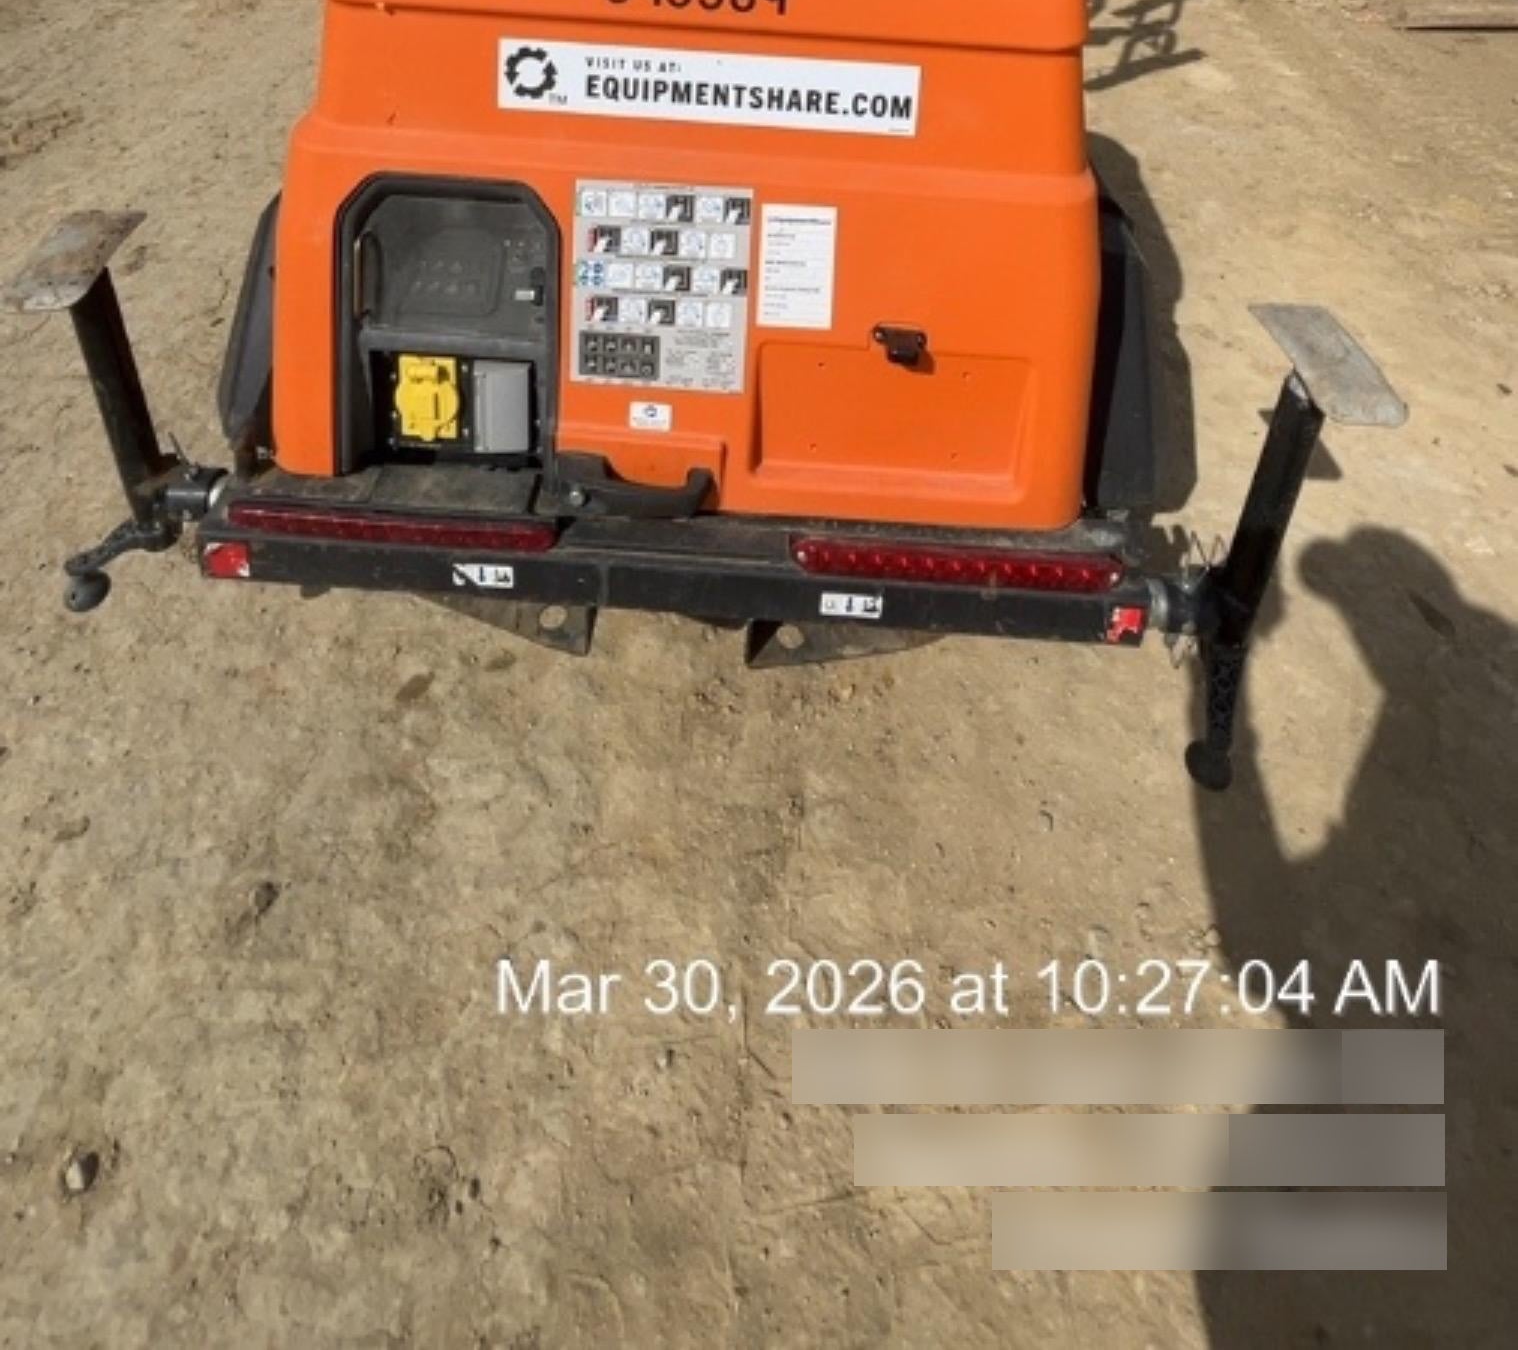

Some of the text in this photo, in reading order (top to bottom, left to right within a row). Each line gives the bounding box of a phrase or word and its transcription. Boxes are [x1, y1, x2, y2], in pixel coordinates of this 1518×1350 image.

[586, 57, 626, 70] VISIT
[633, 59, 653, 72] US
[585, 74, 912, 120] EQUIPMENTSHARE.COM
